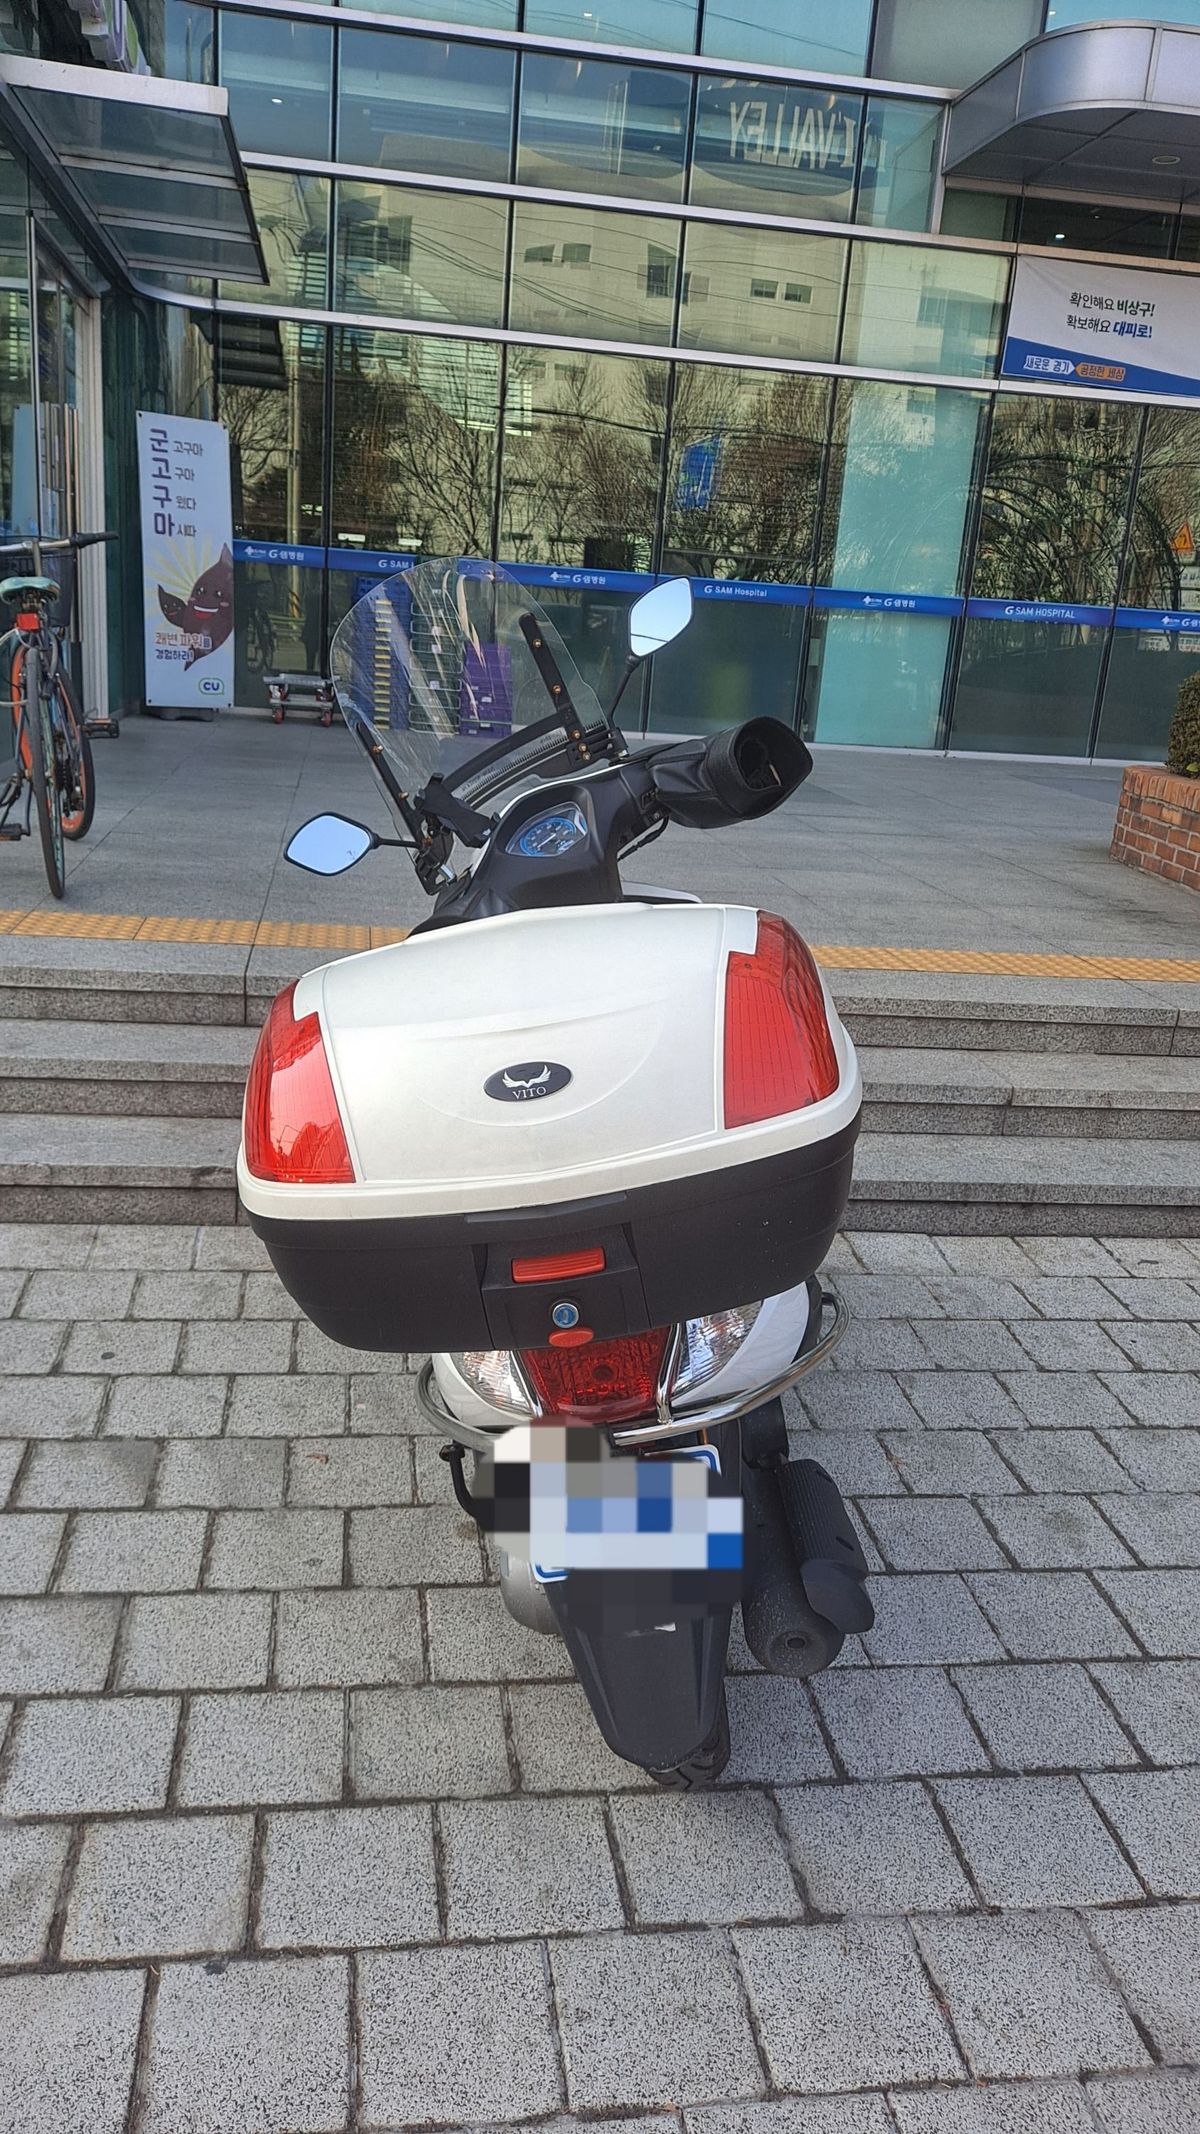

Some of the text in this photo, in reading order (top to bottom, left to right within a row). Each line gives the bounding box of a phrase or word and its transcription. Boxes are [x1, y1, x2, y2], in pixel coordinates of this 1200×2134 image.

[1069, 292, 1155, 317] 확인해요 비상구!
[1066, 314, 1153, 339] 확보해요 대피로!
[1025, 356, 1070, 373] 새로운 경기
[1080, 363, 1125, 380] 공정한 세상
[173, 440, 203, 456] 고구마
[174, 466, 195, 481] 구마
[390, 560, 409, 569] SAM
[715, 586, 733, 595] SAM
[734, 587, 767, 597] Hospital
[1015, 606, 1034, 616] SAM
[1035, 608, 1075, 619] HOSPITAL
[203, 681, 220, 691] CU
[512, 1086, 547, 1100] VITO
